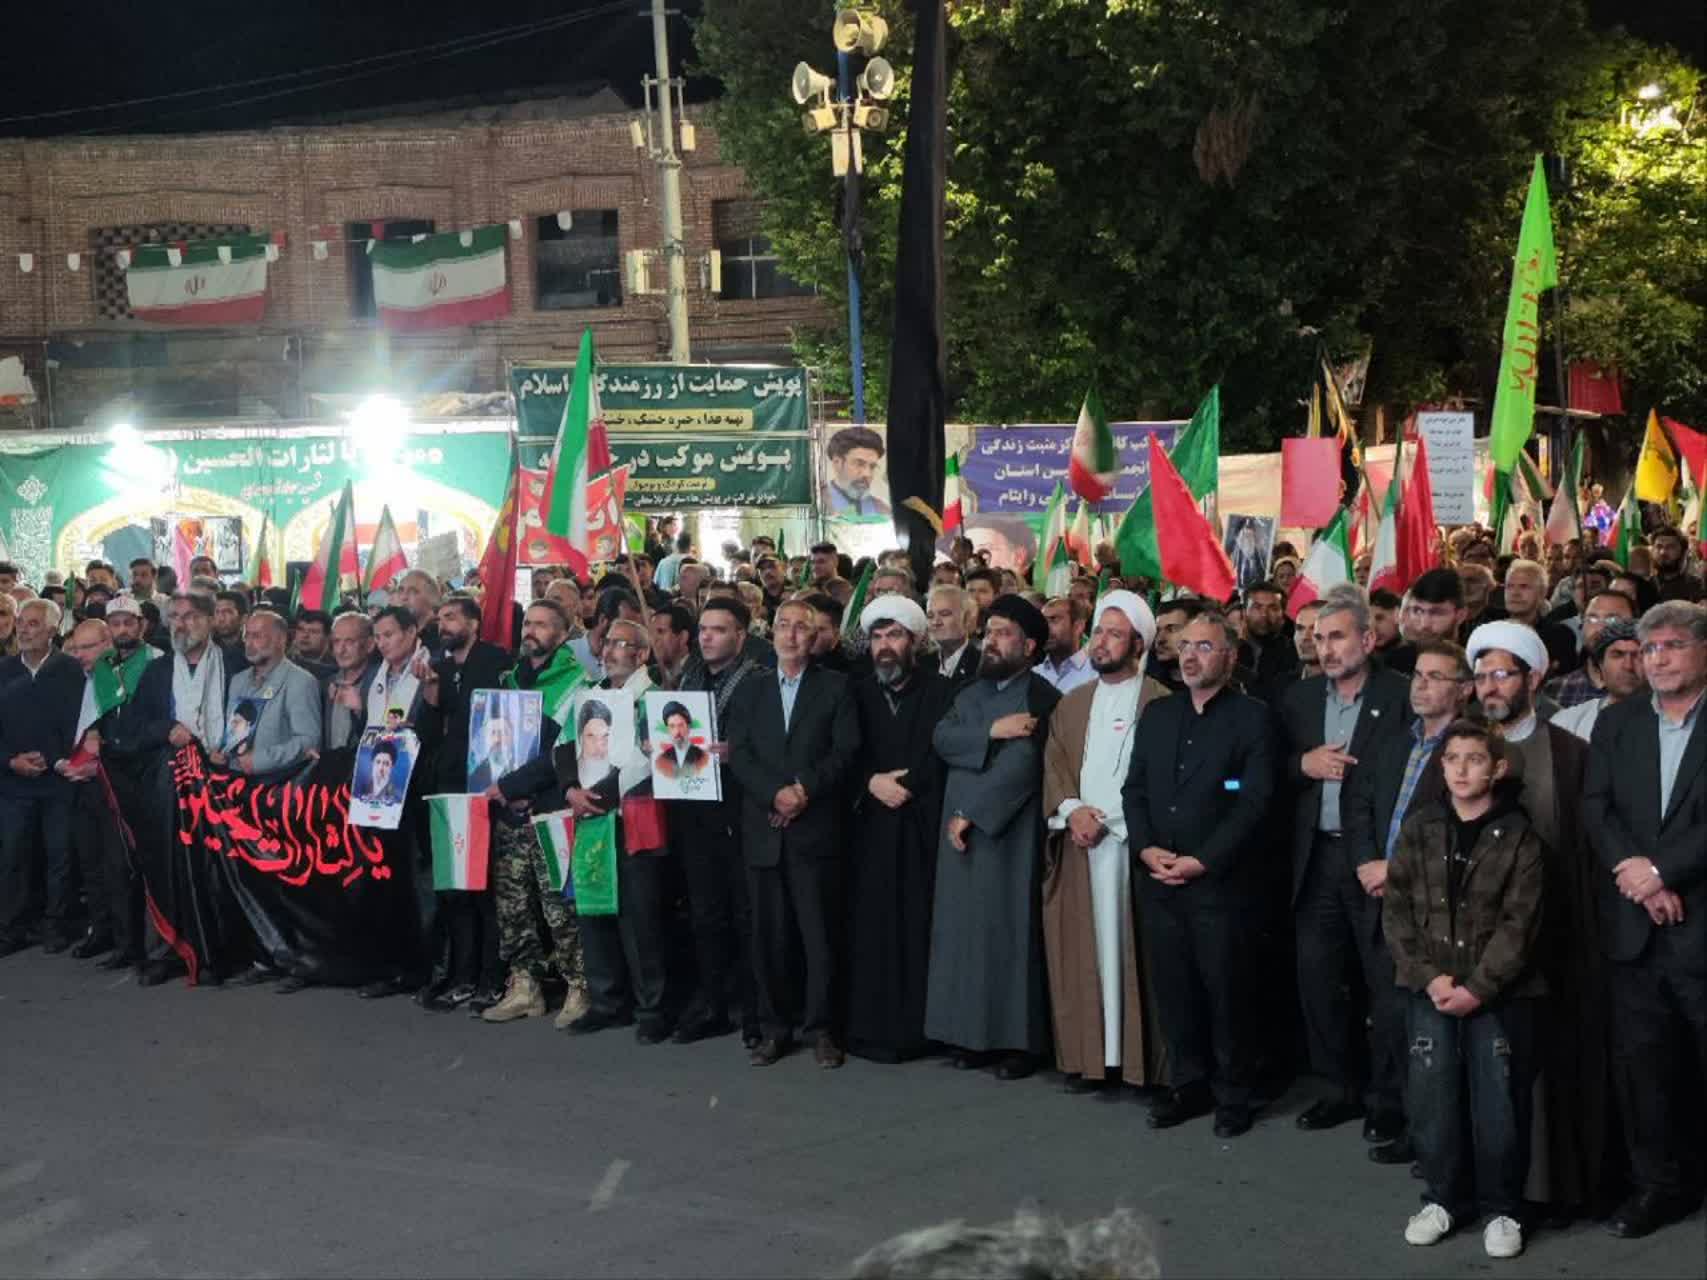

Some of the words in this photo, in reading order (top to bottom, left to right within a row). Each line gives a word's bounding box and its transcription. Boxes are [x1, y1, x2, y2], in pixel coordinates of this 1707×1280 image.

[520, 373, 569, 400] اسلام
[597, 373, 663, 399] رزمندگ
[667, 372, 685, 399] از
[688, 371, 749, 397] حمایت
[753, 372, 802, 397] پویش
[655, 443, 715, 475] موکب
[981, 438, 1024, 455] زندگی
